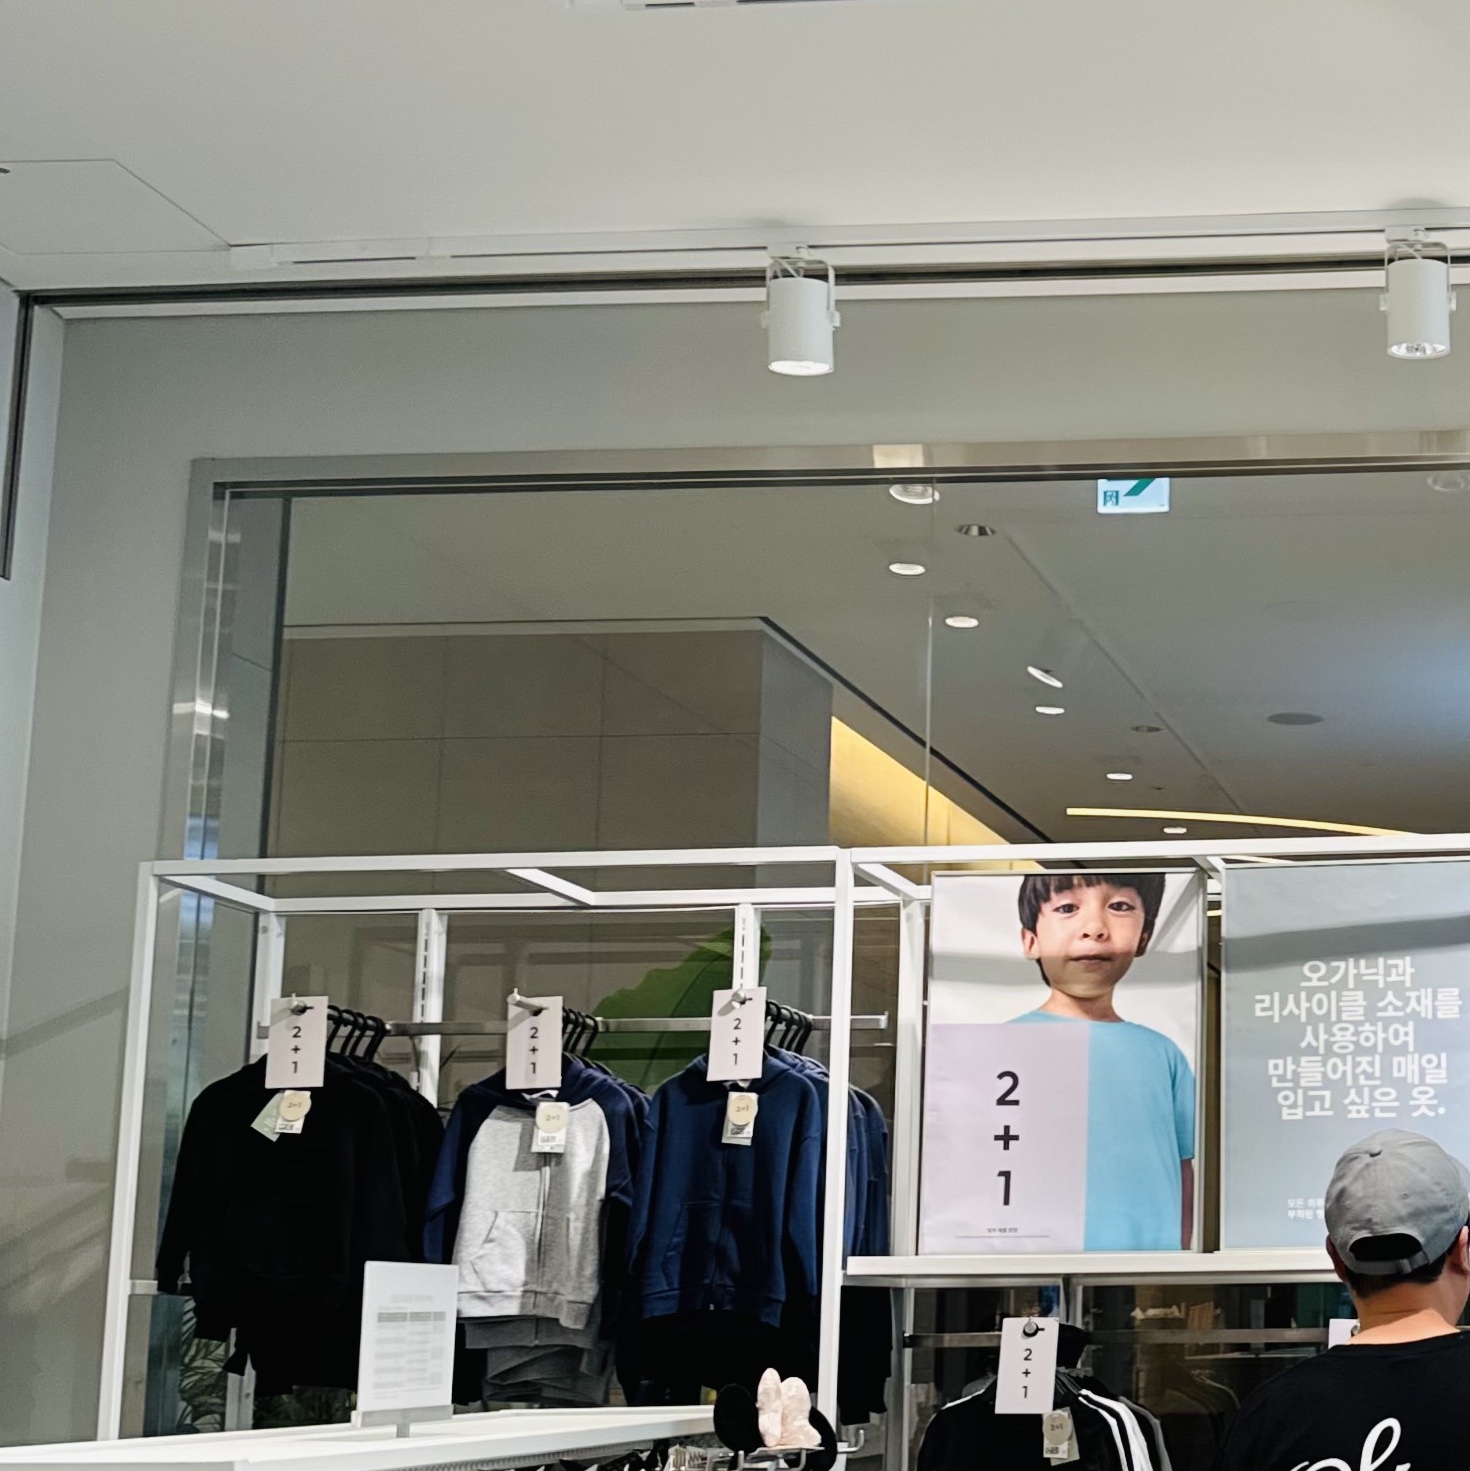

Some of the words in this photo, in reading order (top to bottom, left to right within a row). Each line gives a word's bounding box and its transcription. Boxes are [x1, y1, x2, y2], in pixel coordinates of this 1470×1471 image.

[1300, 957, 1416, 990] 오가닉과
[1254, 990, 1368, 1023] 리사이클
[1376, 988, 1463, 1020] 소재를
[1300, 1022, 1416, 1055] 사용하여
[1267, 1054, 1383, 1088] 만들어진
[1392, 1052, 1449, 1085] 매일
[1277, 1088, 1335, 1121] 입고
[1343, 1086, 1400, 1120] 싶은
[1409, 1086, 1446, 1119] 옷.
